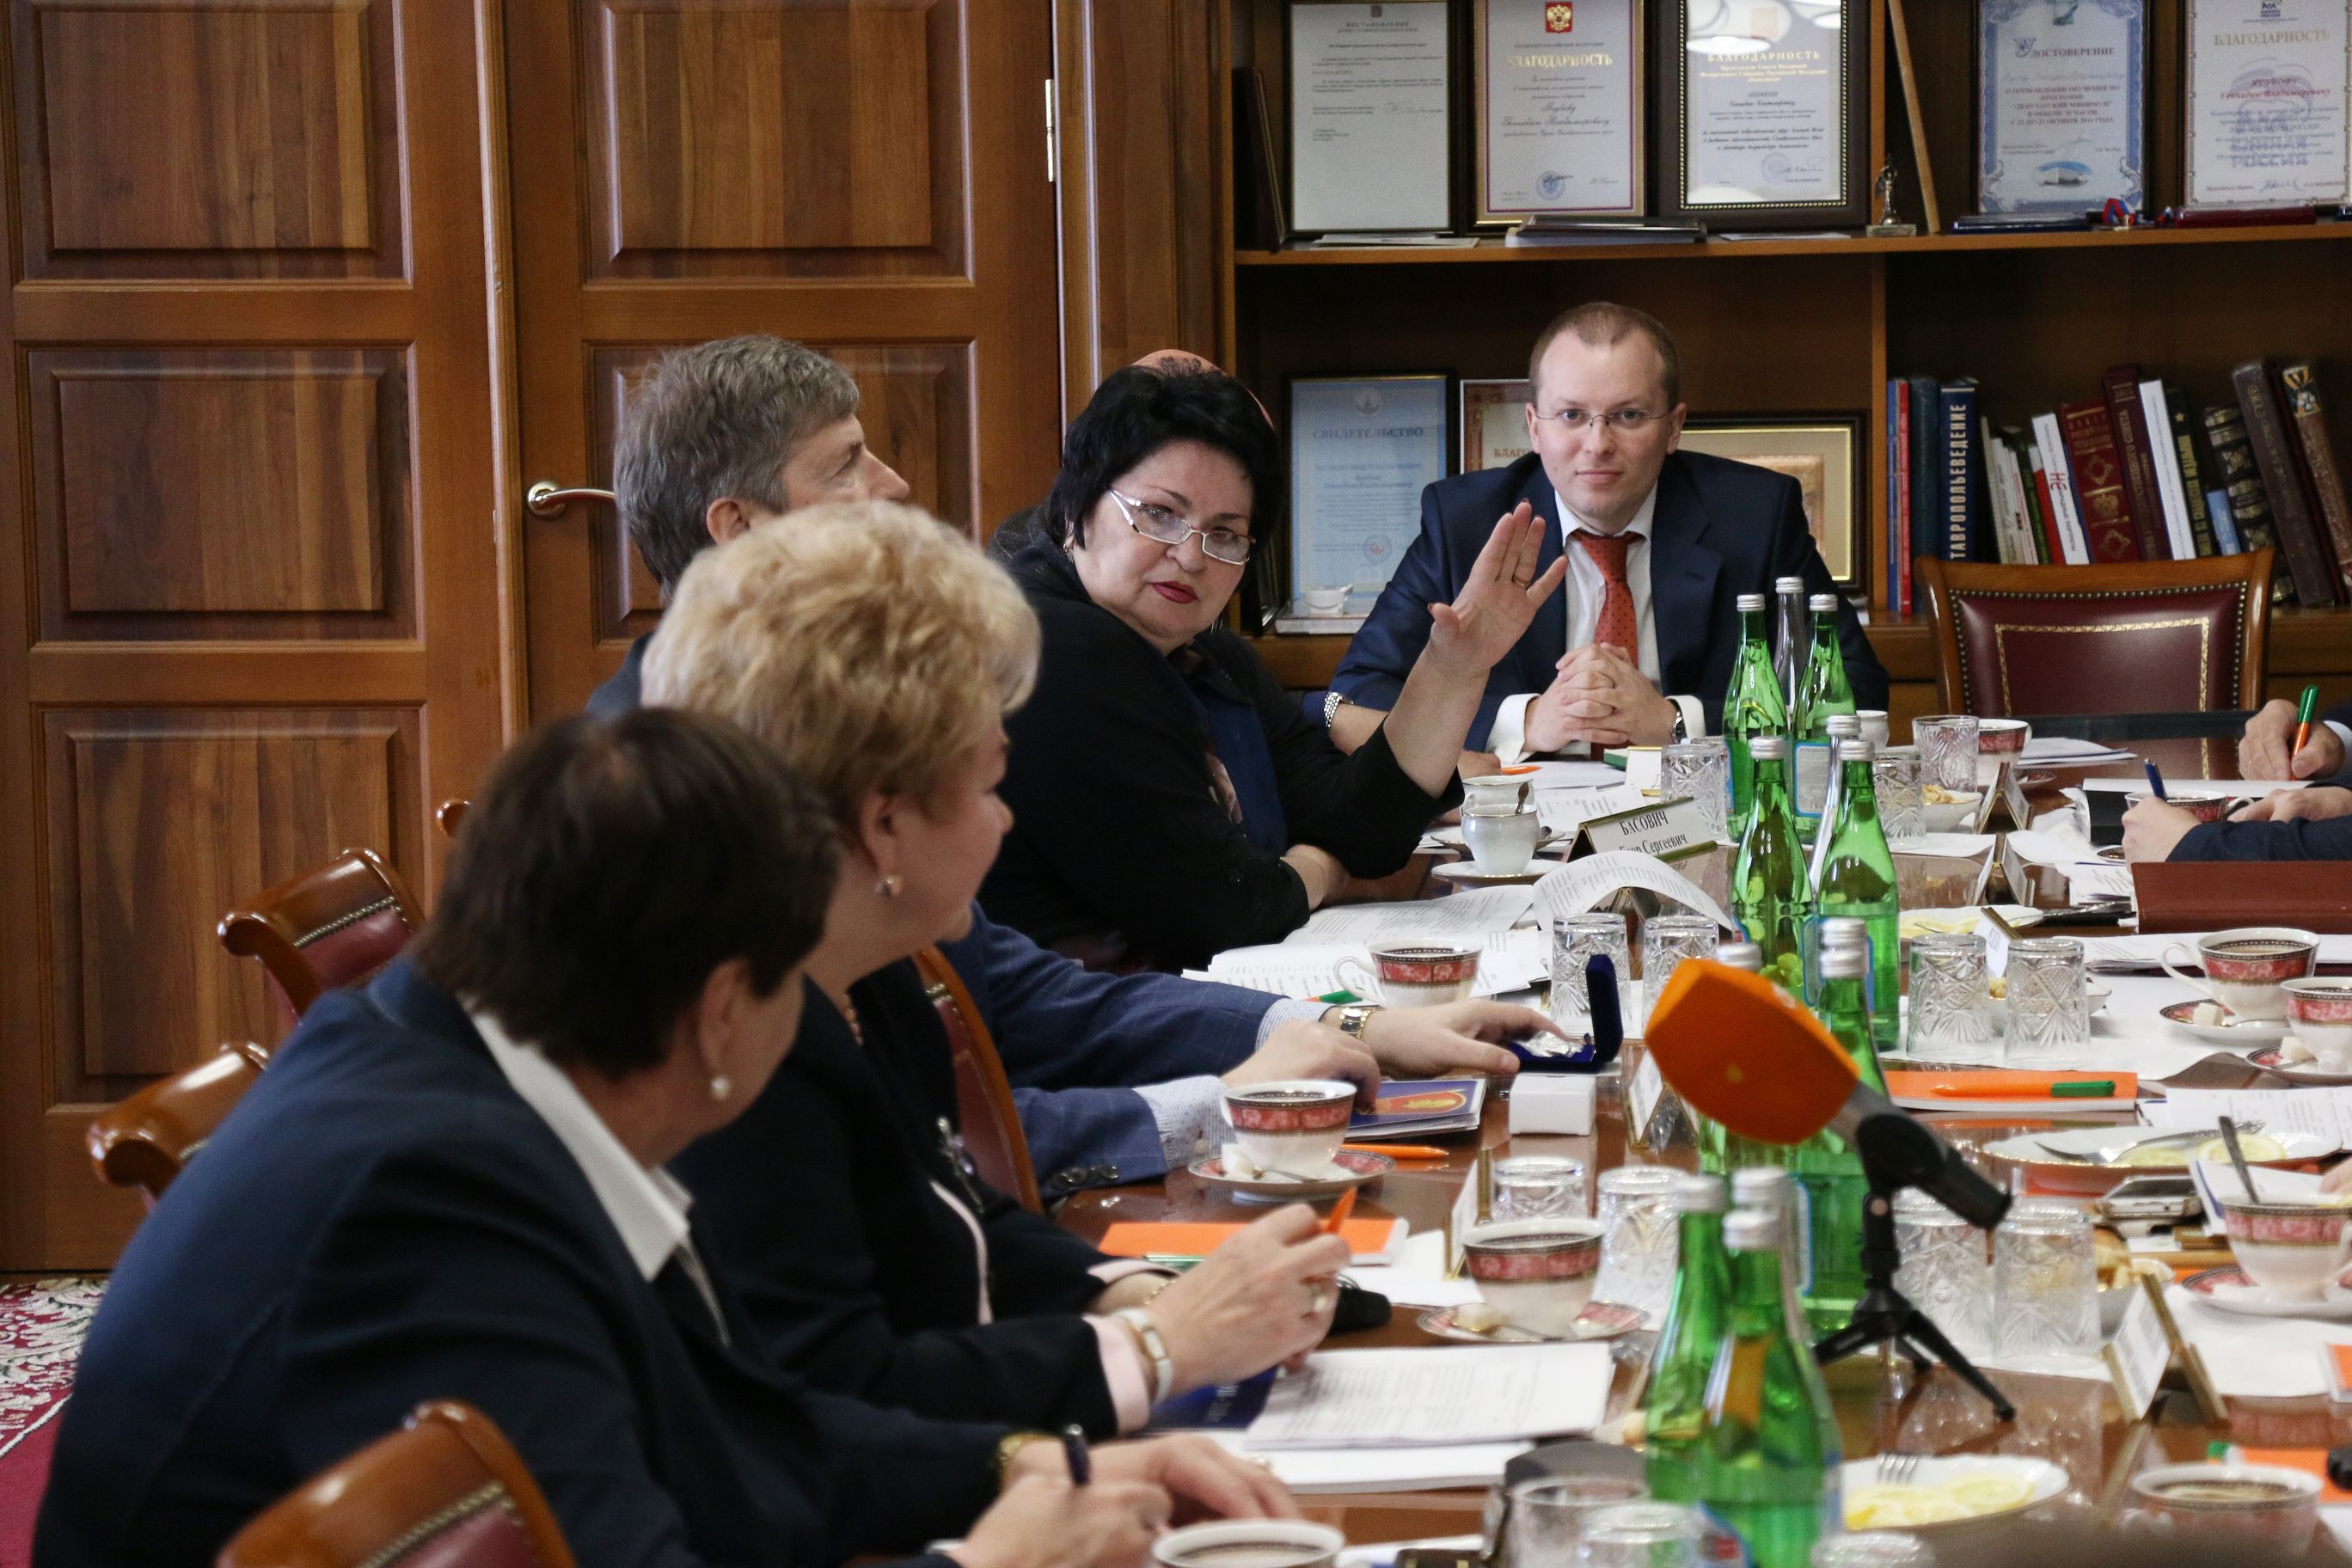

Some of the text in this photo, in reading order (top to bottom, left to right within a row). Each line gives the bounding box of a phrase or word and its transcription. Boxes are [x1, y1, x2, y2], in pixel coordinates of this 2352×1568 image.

[2214, 28, 2331, 47] БЛАГОДАРНОСТЬ
[1950, 404, 1969, 560] ТАВРОПОЛЬЕВЕДЕНИЕ
[1619, 811, 1669, 836] БАСОВИЧ
[1642, 834, 1687, 856] Сергеевич
